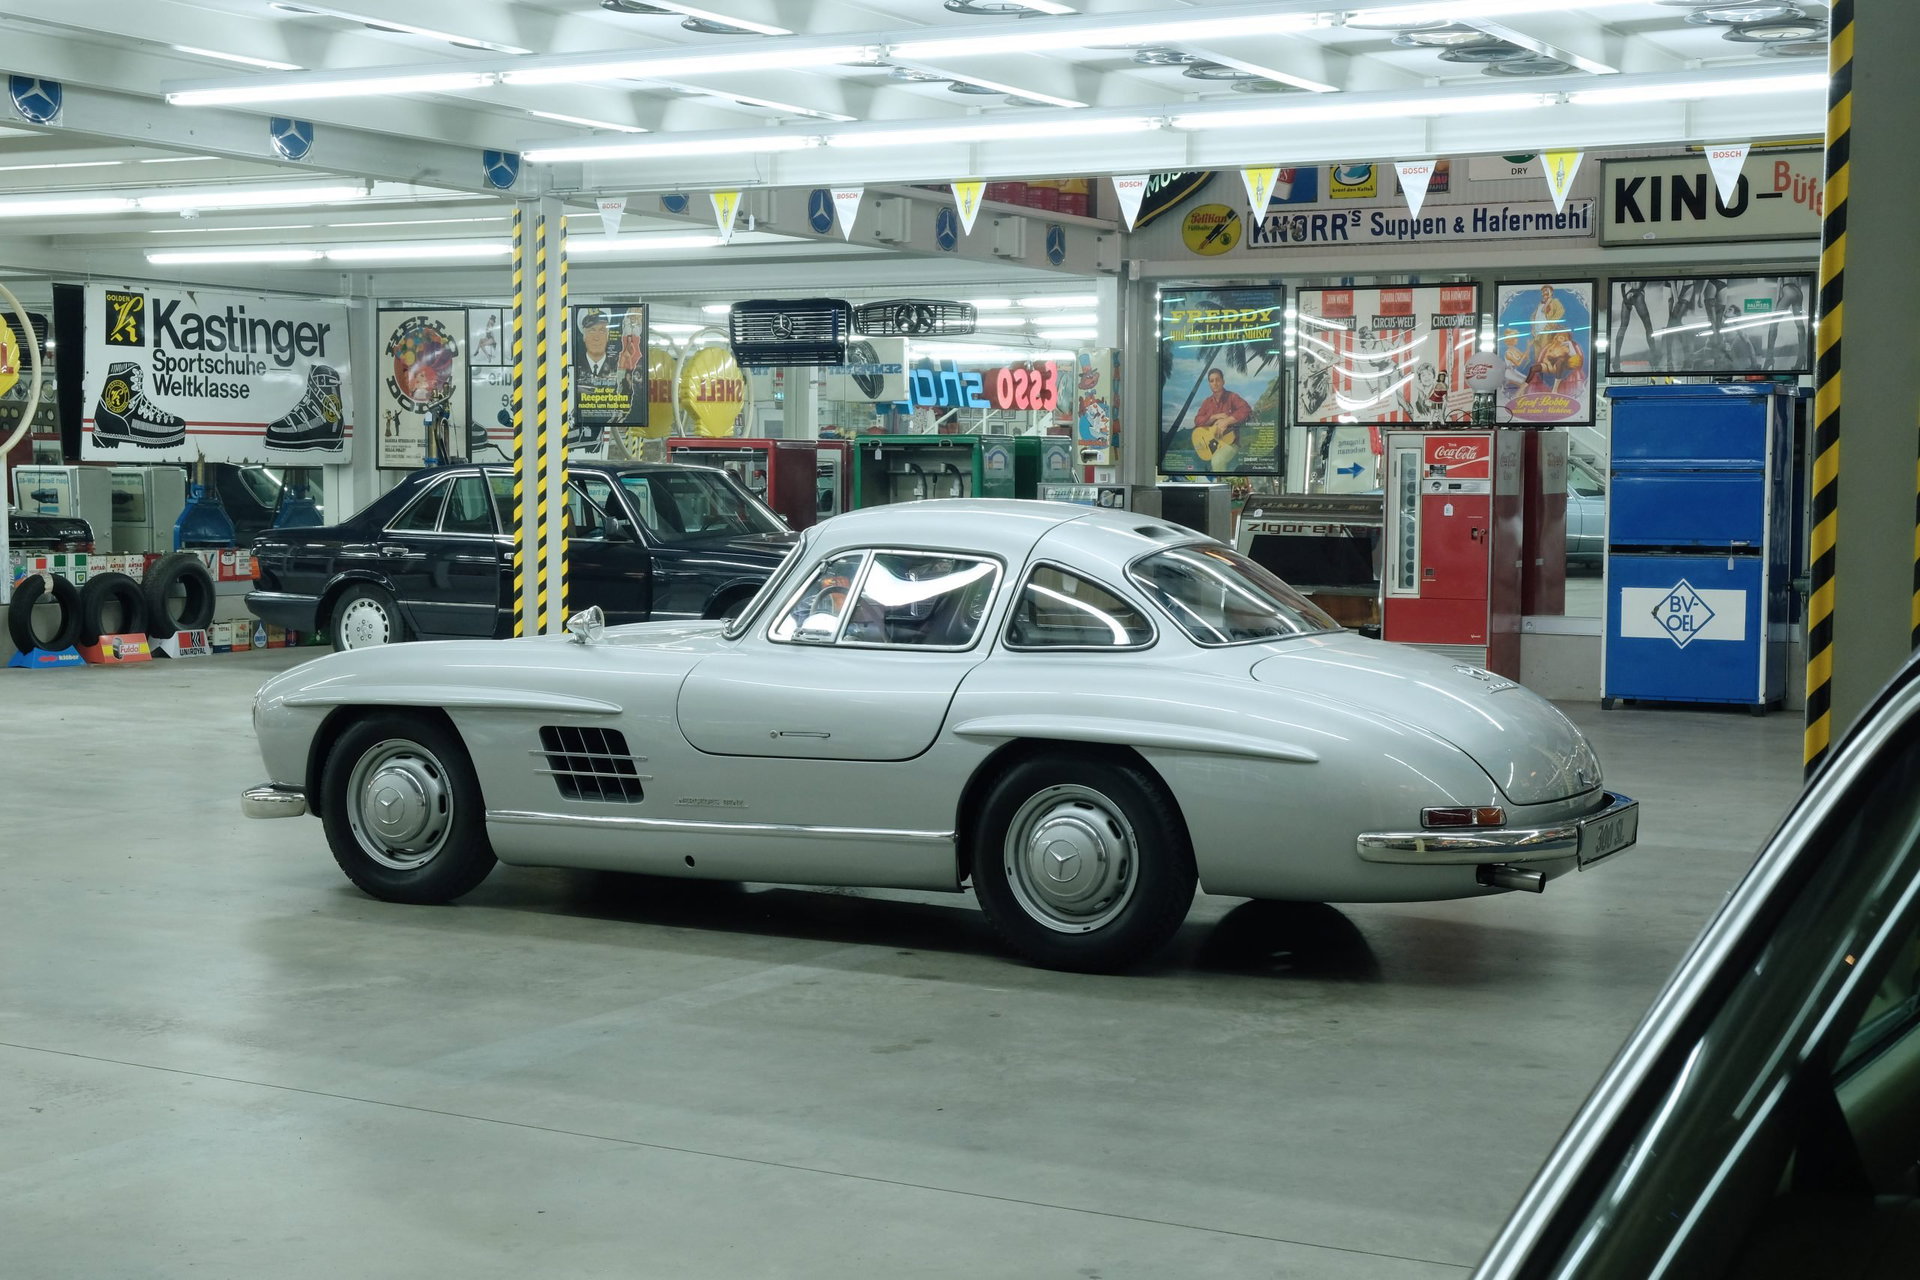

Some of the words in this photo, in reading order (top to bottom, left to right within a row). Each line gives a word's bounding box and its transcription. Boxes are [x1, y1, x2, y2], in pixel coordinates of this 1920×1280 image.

[1712, 150, 1742, 159] BOSCH
[1402, 167, 1429, 175] BOSCH
[1511, 167, 1528, 175] DRY
[836, 192, 858, 200] BOSCH
[1370, 211, 1447, 240] Suppen
[1453, 216, 1465, 233] &
[1472, 203, 1588, 233] Hafermehl
[106, 294, 130, 302] GOLDEN
[1170, 308, 1274, 324] FREDDY
[152, 298, 331, 367] Kastinger
[152, 348, 267, 377] Sportschuhe
[152, 373, 251, 399] Weltklasse
[581, 392, 629, 404] Reeperbahn
[1539, 395, 1570, 407] Bobby
[1434, 445, 1480, 460] Coca-Cola
[1666, 613, 1698, 632] OEL
[119, 645, 140, 653] Fulda
[179, 648, 206, 656] UNIROYAL
